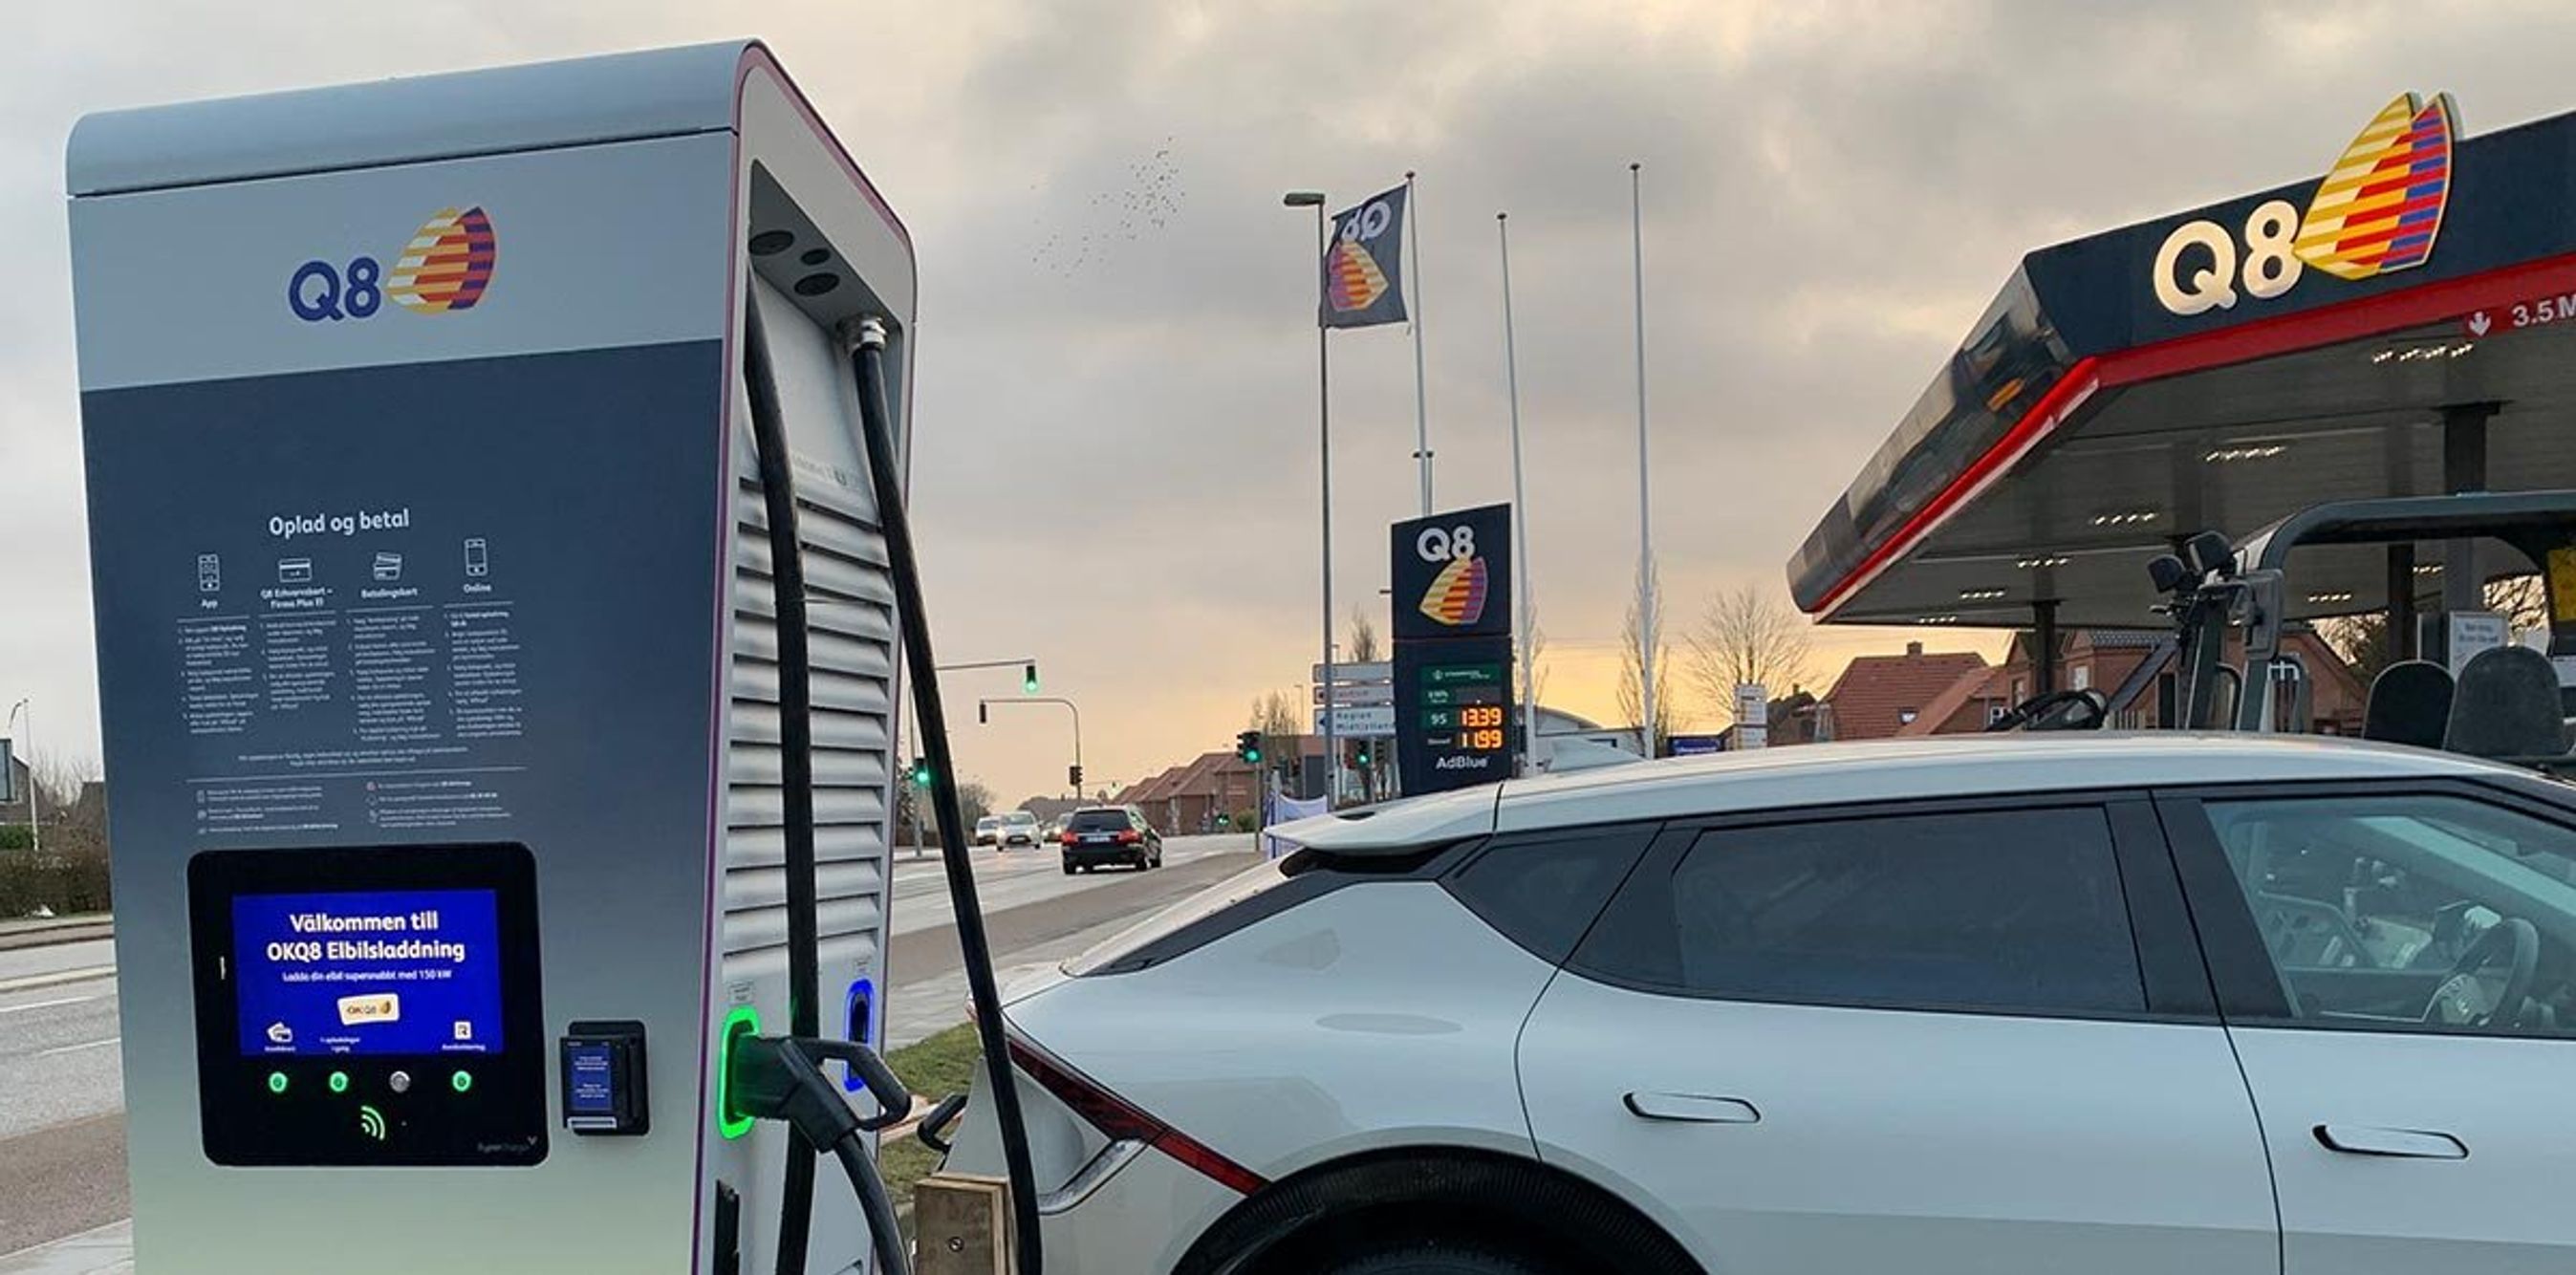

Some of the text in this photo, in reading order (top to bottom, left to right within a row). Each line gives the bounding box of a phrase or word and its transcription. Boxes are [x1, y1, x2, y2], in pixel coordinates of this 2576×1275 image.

[2154, 200, 2303, 314] Q8
[289, 256, 381, 321] Q8
[269, 508, 410, 539] Oplad og betal
[1417, 526, 1476, 562] Q8
[463, 583, 492, 594] Online
[201, 598, 219, 609] App
[1431, 713, 1448, 725] 95
[1436, 755, 1487, 770] AdBlue
[290, 911, 439, 933] Välkommen till
[267, 940, 465, 962] OKQ8 Elbilsladdning
[419, 969, 435, 980] 150
